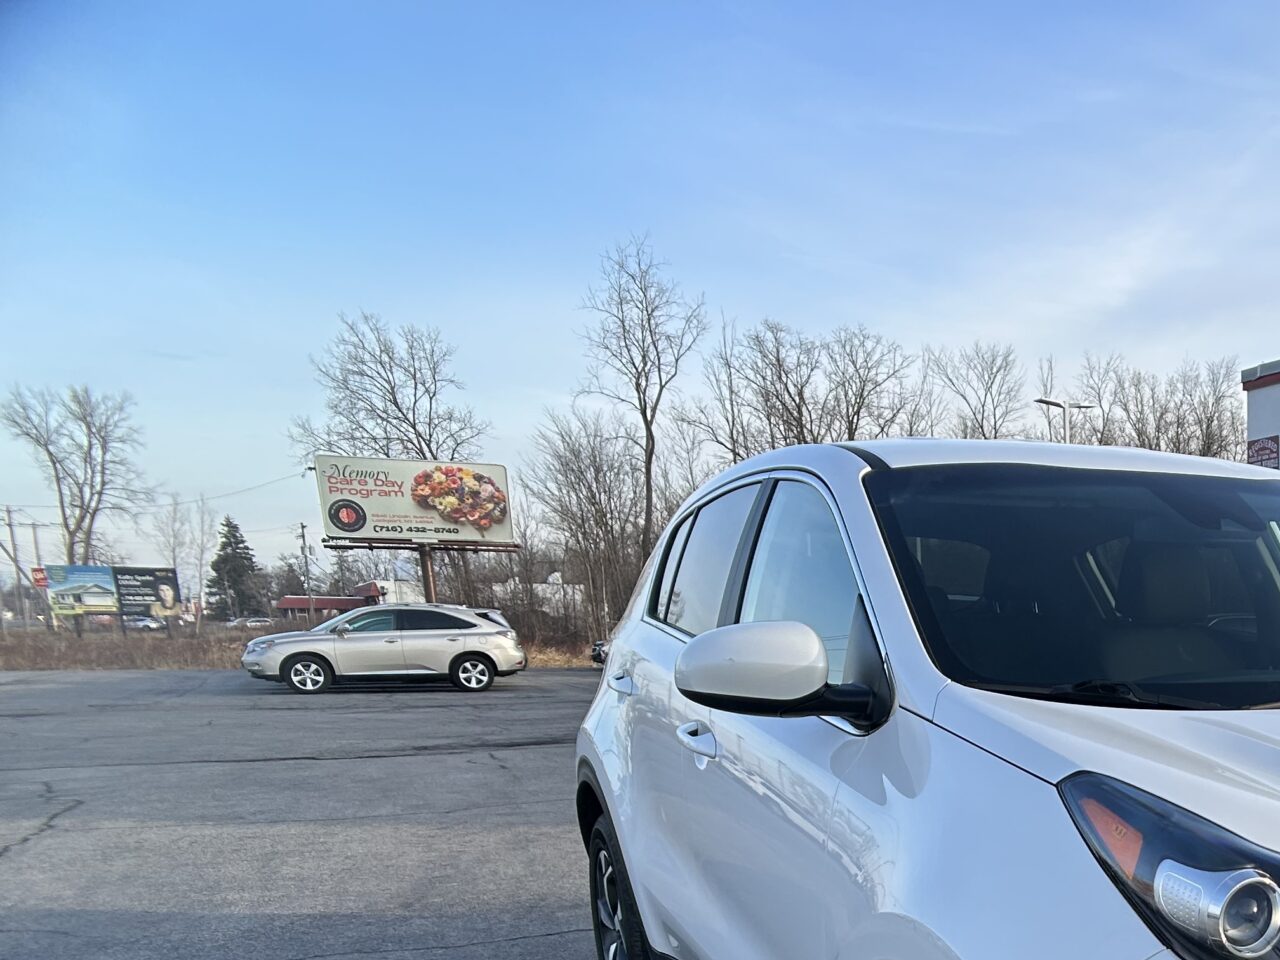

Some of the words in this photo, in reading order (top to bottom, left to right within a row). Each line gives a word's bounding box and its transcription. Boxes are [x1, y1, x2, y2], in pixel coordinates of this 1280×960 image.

[321, 463, 390, 481] Memory
[327, 476, 369, 486] Care
[373, 479, 405, 490] Day
[328, 485, 405, 498] Program
[373, 524, 404, 534] (716)
